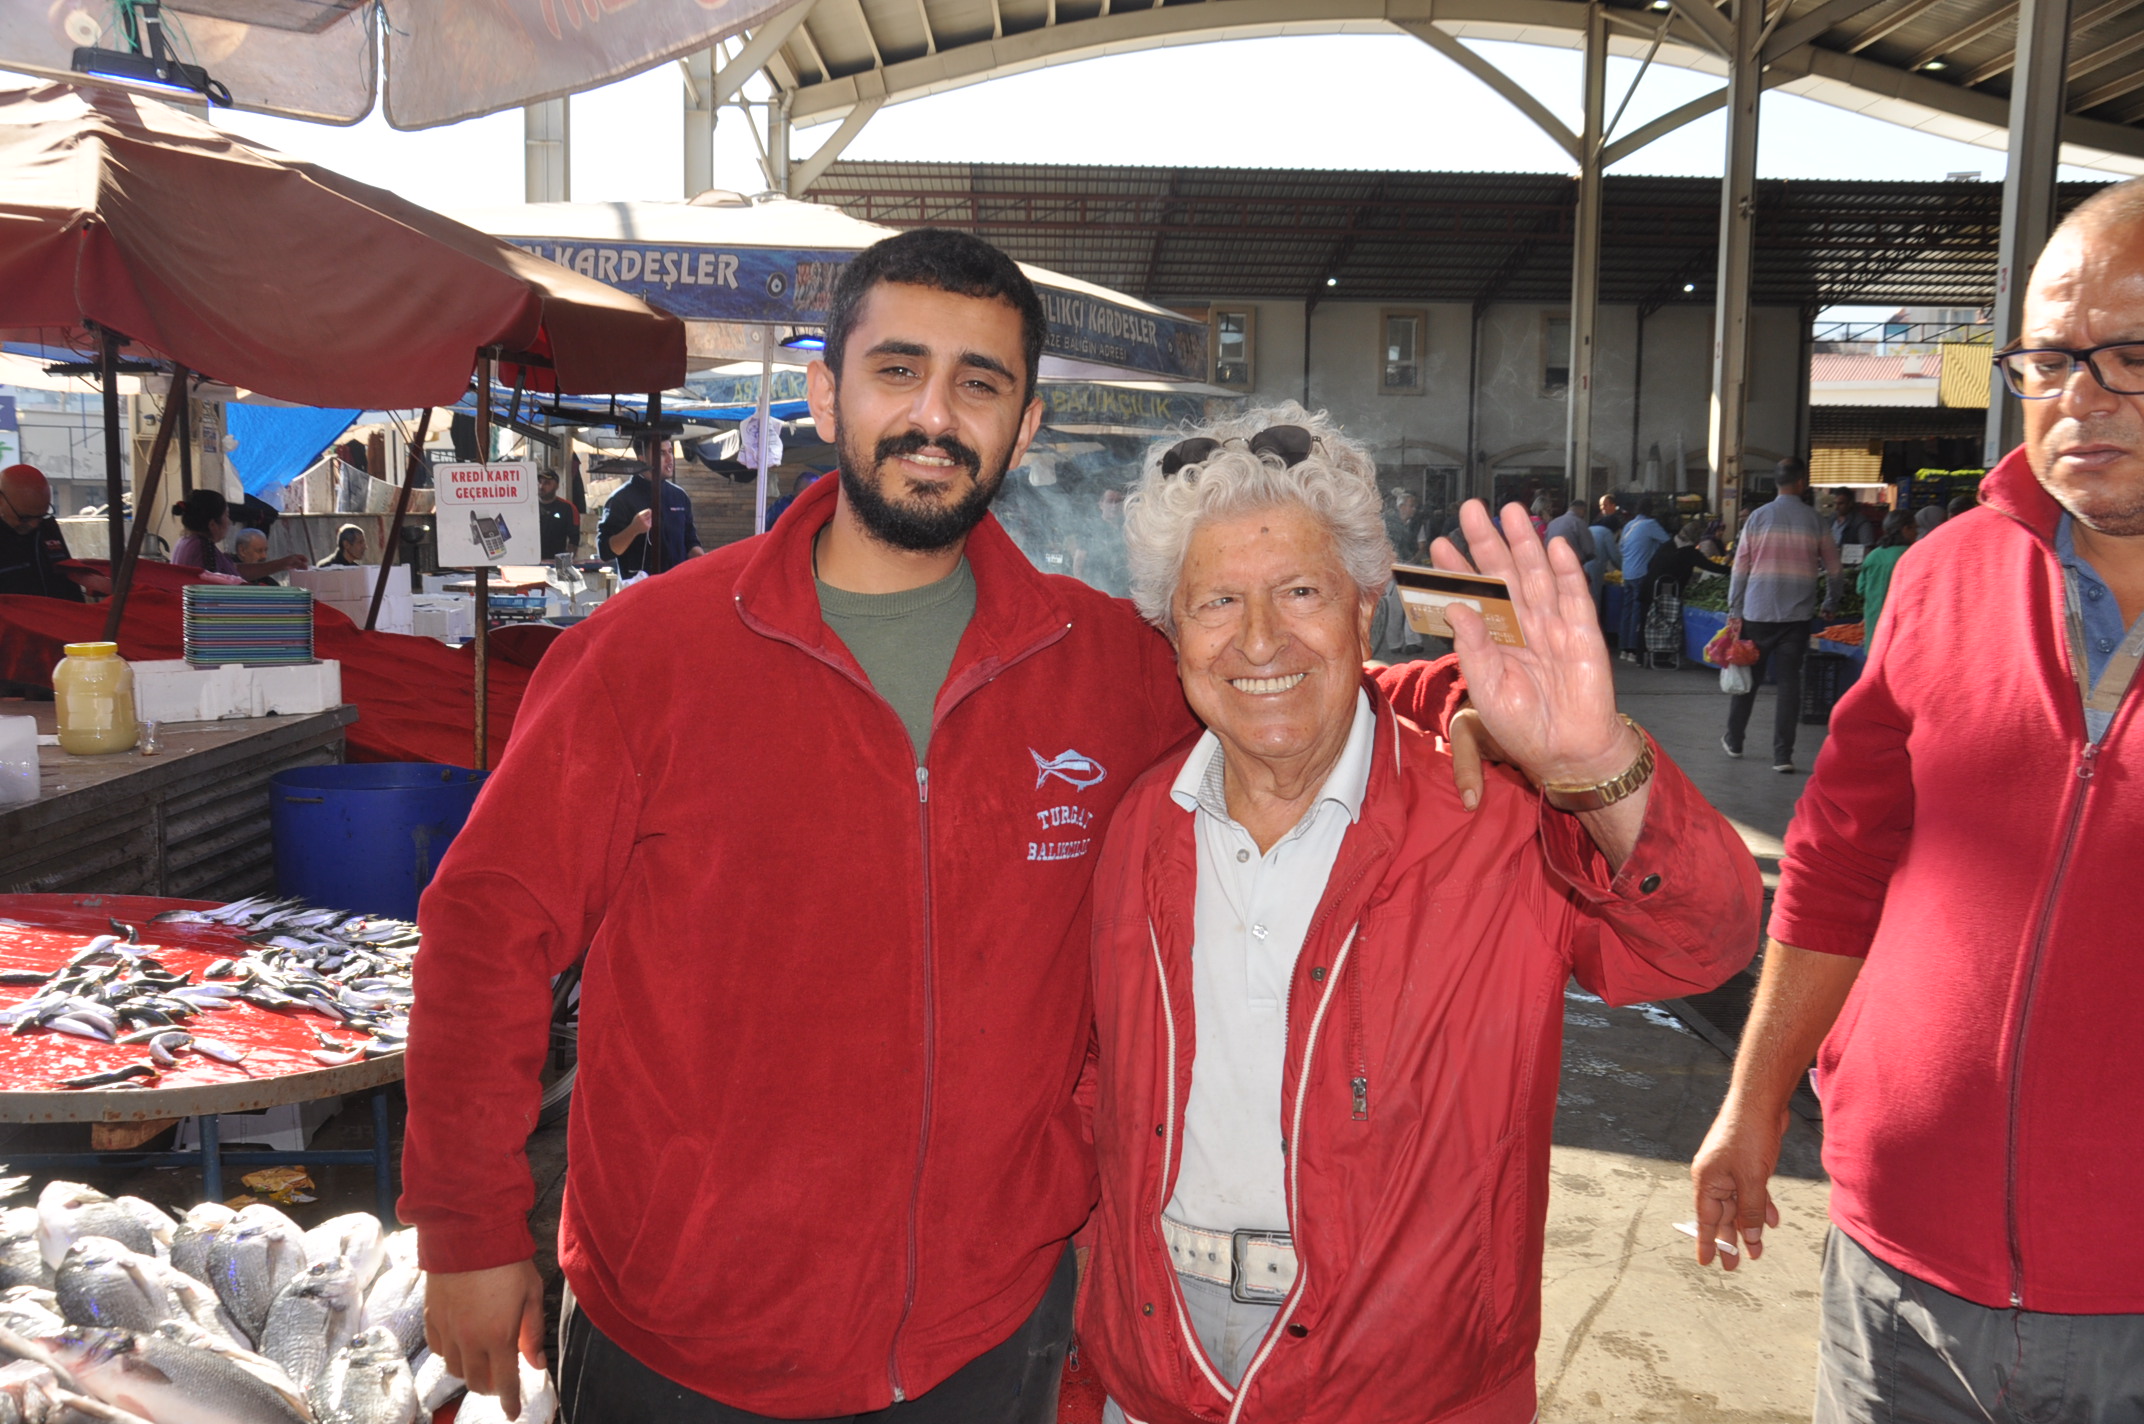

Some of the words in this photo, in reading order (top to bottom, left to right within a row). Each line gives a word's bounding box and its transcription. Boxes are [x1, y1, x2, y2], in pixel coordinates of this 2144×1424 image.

[555, 246, 739, 290] KARDEŞLER
[1088, 302, 1158, 347] KARDEŞLER
[1052, 389, 1172, 420] BALIKÇILIK
[451, 469, 484, 482] KREDİ
[487, 470, 520, 482] KARTI
[455, 484, 517, 501] GEÇERLİDİR
